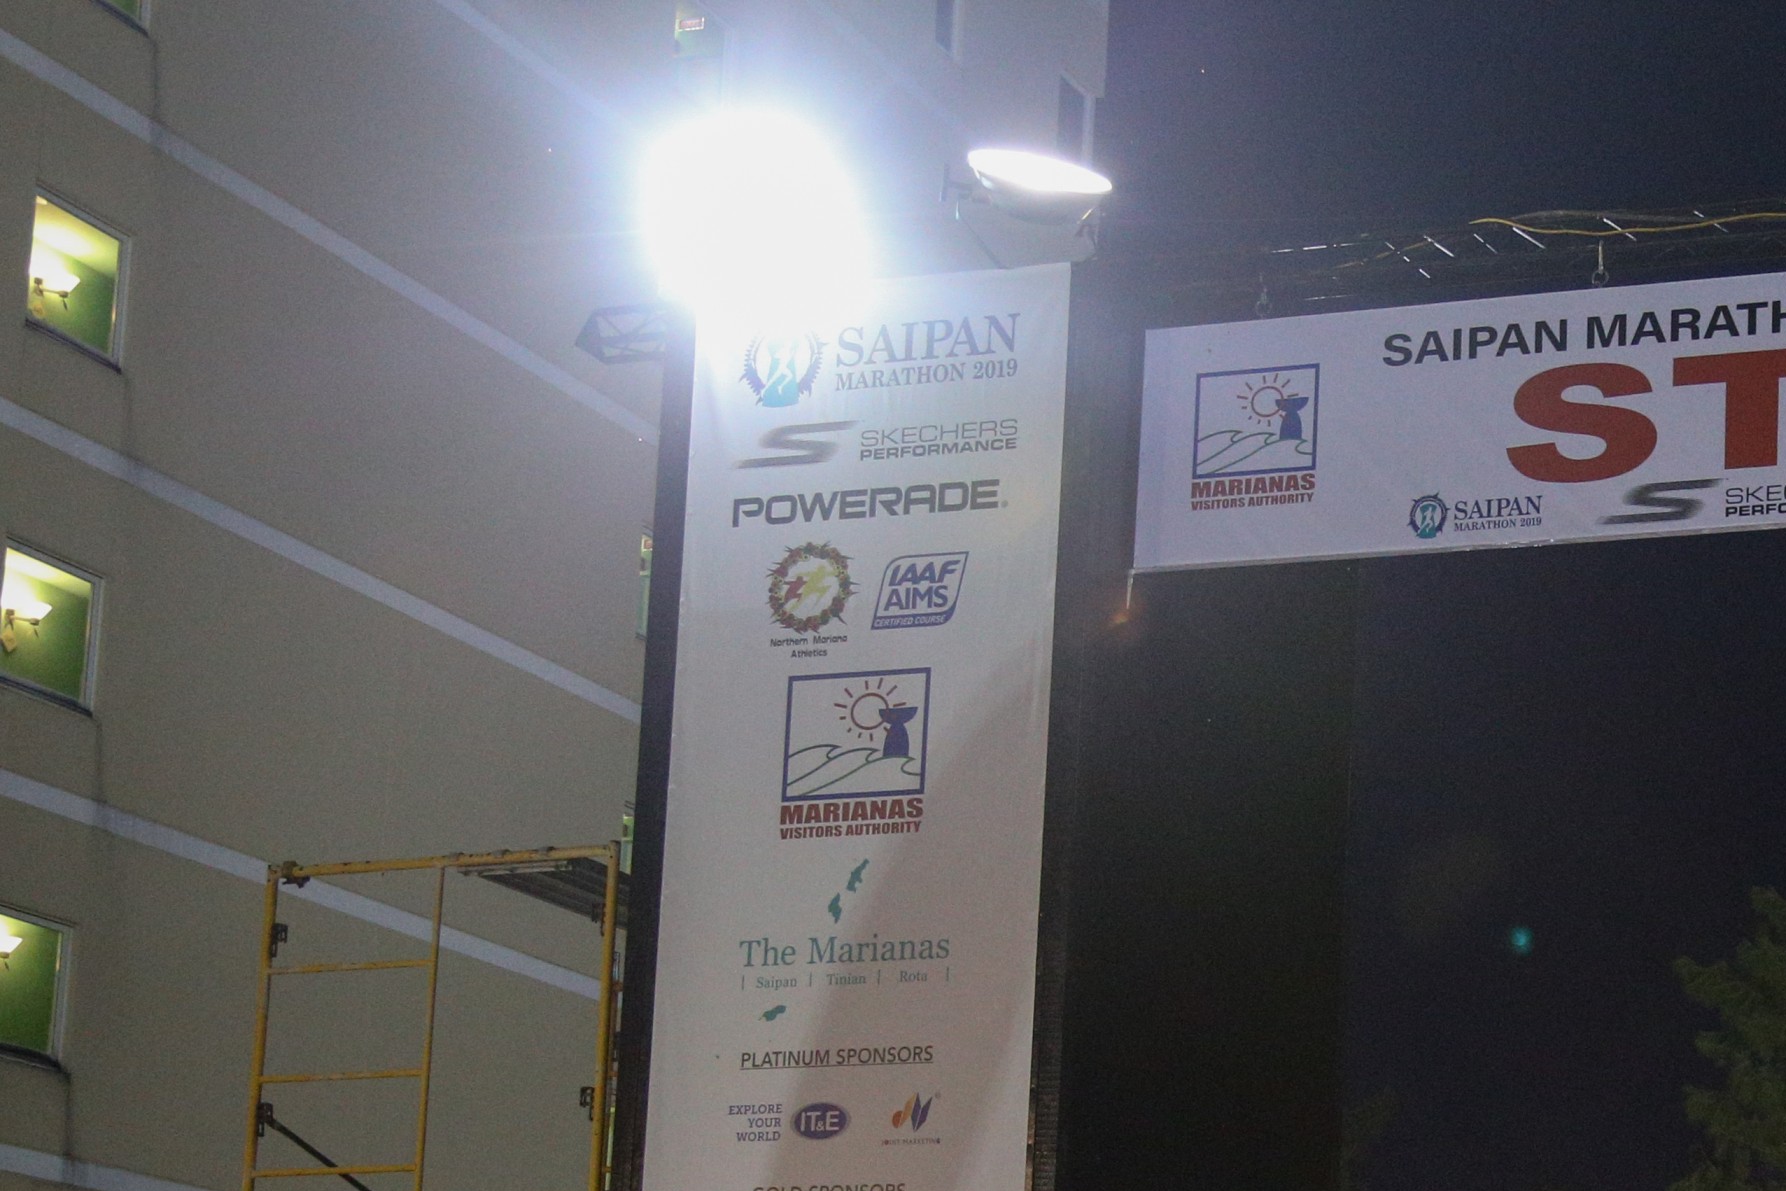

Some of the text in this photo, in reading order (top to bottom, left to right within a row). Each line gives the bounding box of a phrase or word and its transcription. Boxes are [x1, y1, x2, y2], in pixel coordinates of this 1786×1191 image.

[835, 313, 1020, 368] SAIPAN
[1381, 317, 1569, 367] SAIPAN
[835, 358, 1018, 392] MARATHON 2019
[860, 419, 1018, 448] SKECHERS
[860, 438, 1017, 461] PERFORMANCE
[1191, 473, 1316, 499] MARIANAS
[732, 479, 1000, 528] POWERADE
[1191, 492, 1314, 511] VISITORS AUTHORITY
[1453, 495, 1543, 520] SAIPAN
[1454, 515, 1542, 532] MARATHON 2019
[888, 560, 961, 587] IAAF
[883, 584, 948, 611] AIMS
[873, 617, 913, 628] CERTIFIED
[770, 637, 808, 648] Northern
[780, 797, 924, 825] MARIANAS
[780, 820, 921, 840] VISITORS AUTHORITY
[739, 933, 950, 967] The Marianas
[755, 970, 928, 990] Saipan Tinian Rota
[741, 1045, 934, 1068] PLATINUM SPONSORS
[728, 1103, 783, 1116] EXPLORE
[800, 1110, 841, 1132] IT&E
[748, 1117, 781, 1129] YOUR
[736, 1131, 780, 1142] WORLD
